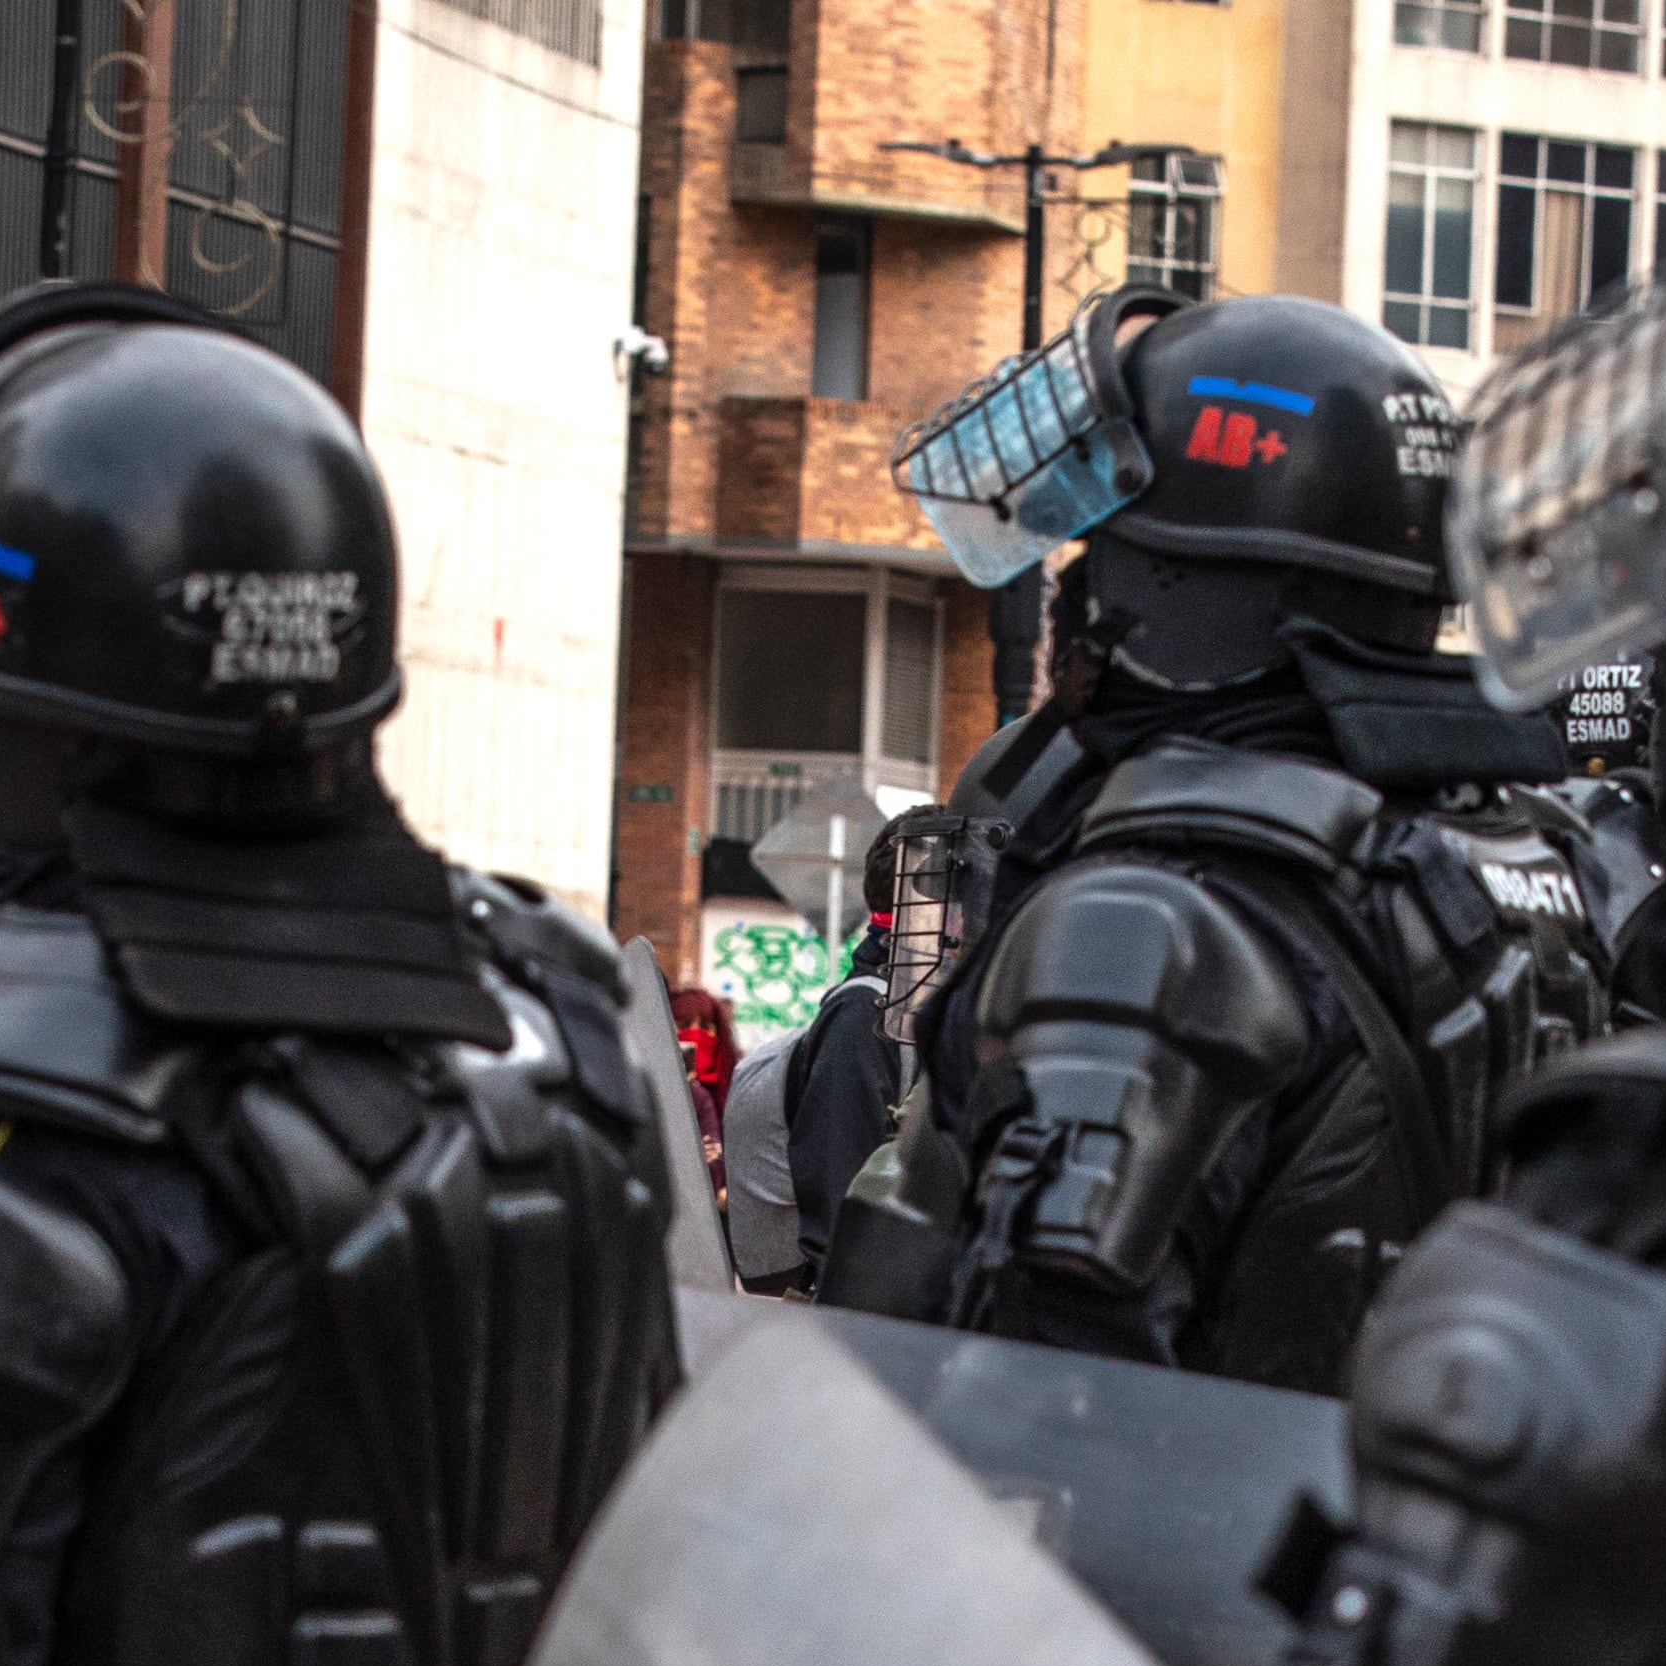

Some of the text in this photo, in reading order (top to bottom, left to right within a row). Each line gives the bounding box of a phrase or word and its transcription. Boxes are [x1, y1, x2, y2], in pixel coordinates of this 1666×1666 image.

[1185, 405, 1288, 468] AB+
[1583, 665, 1642, 690] ORTIZ
[1569, 692, 1625, 716] 45088
[1566, 718, 1632, 744] ESMAD
